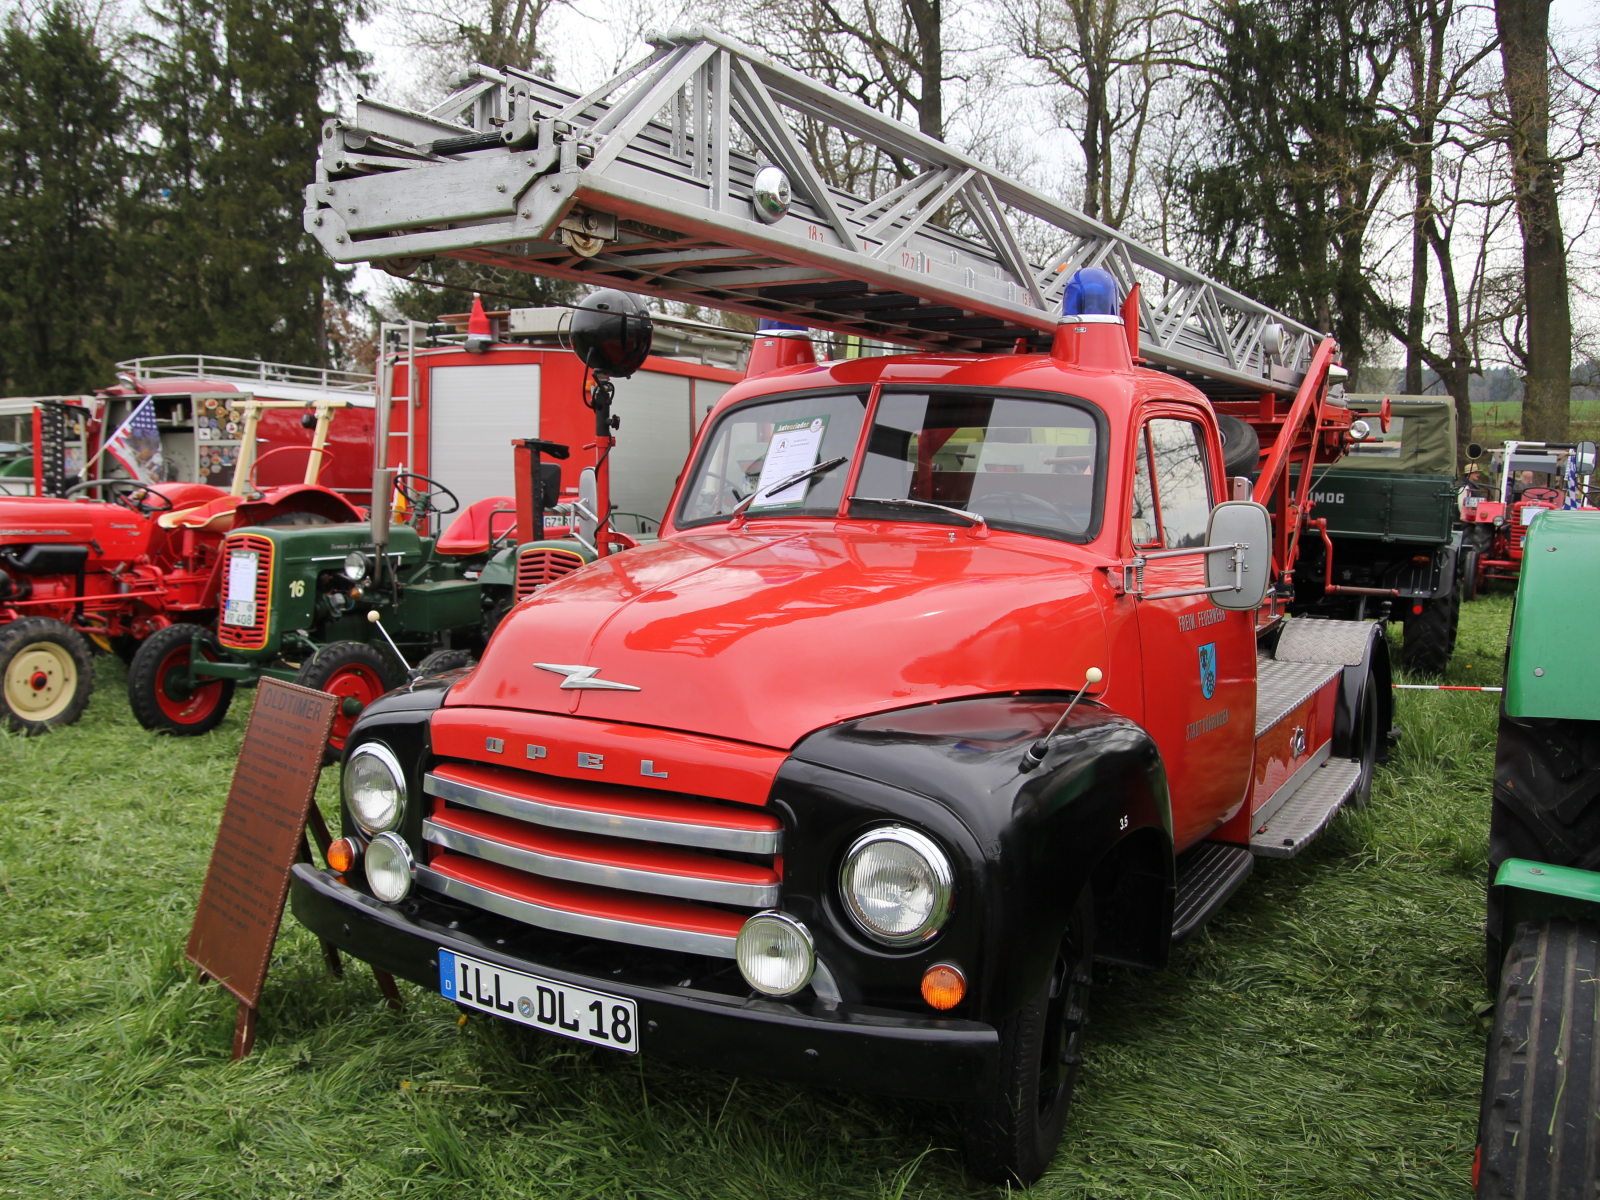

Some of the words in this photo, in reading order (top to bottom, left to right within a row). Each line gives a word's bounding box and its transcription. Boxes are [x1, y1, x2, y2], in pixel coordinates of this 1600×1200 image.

[1290, 490, 1345, 504] UIMOG
[544, 517, 557, 528] GZ
[288, 580, 305, 598] 16
[262, 687, 324, 722] OLDTIMER
[1185, 719, 1203, 741] STADT
[486, 736, 669, 779] OPEL
[445, 979, 452, 990] D
[459, 962, 514, 1014] ILL
[536, 985, 580, 1032] DL
[588, 1000, 632, 1044] 18
